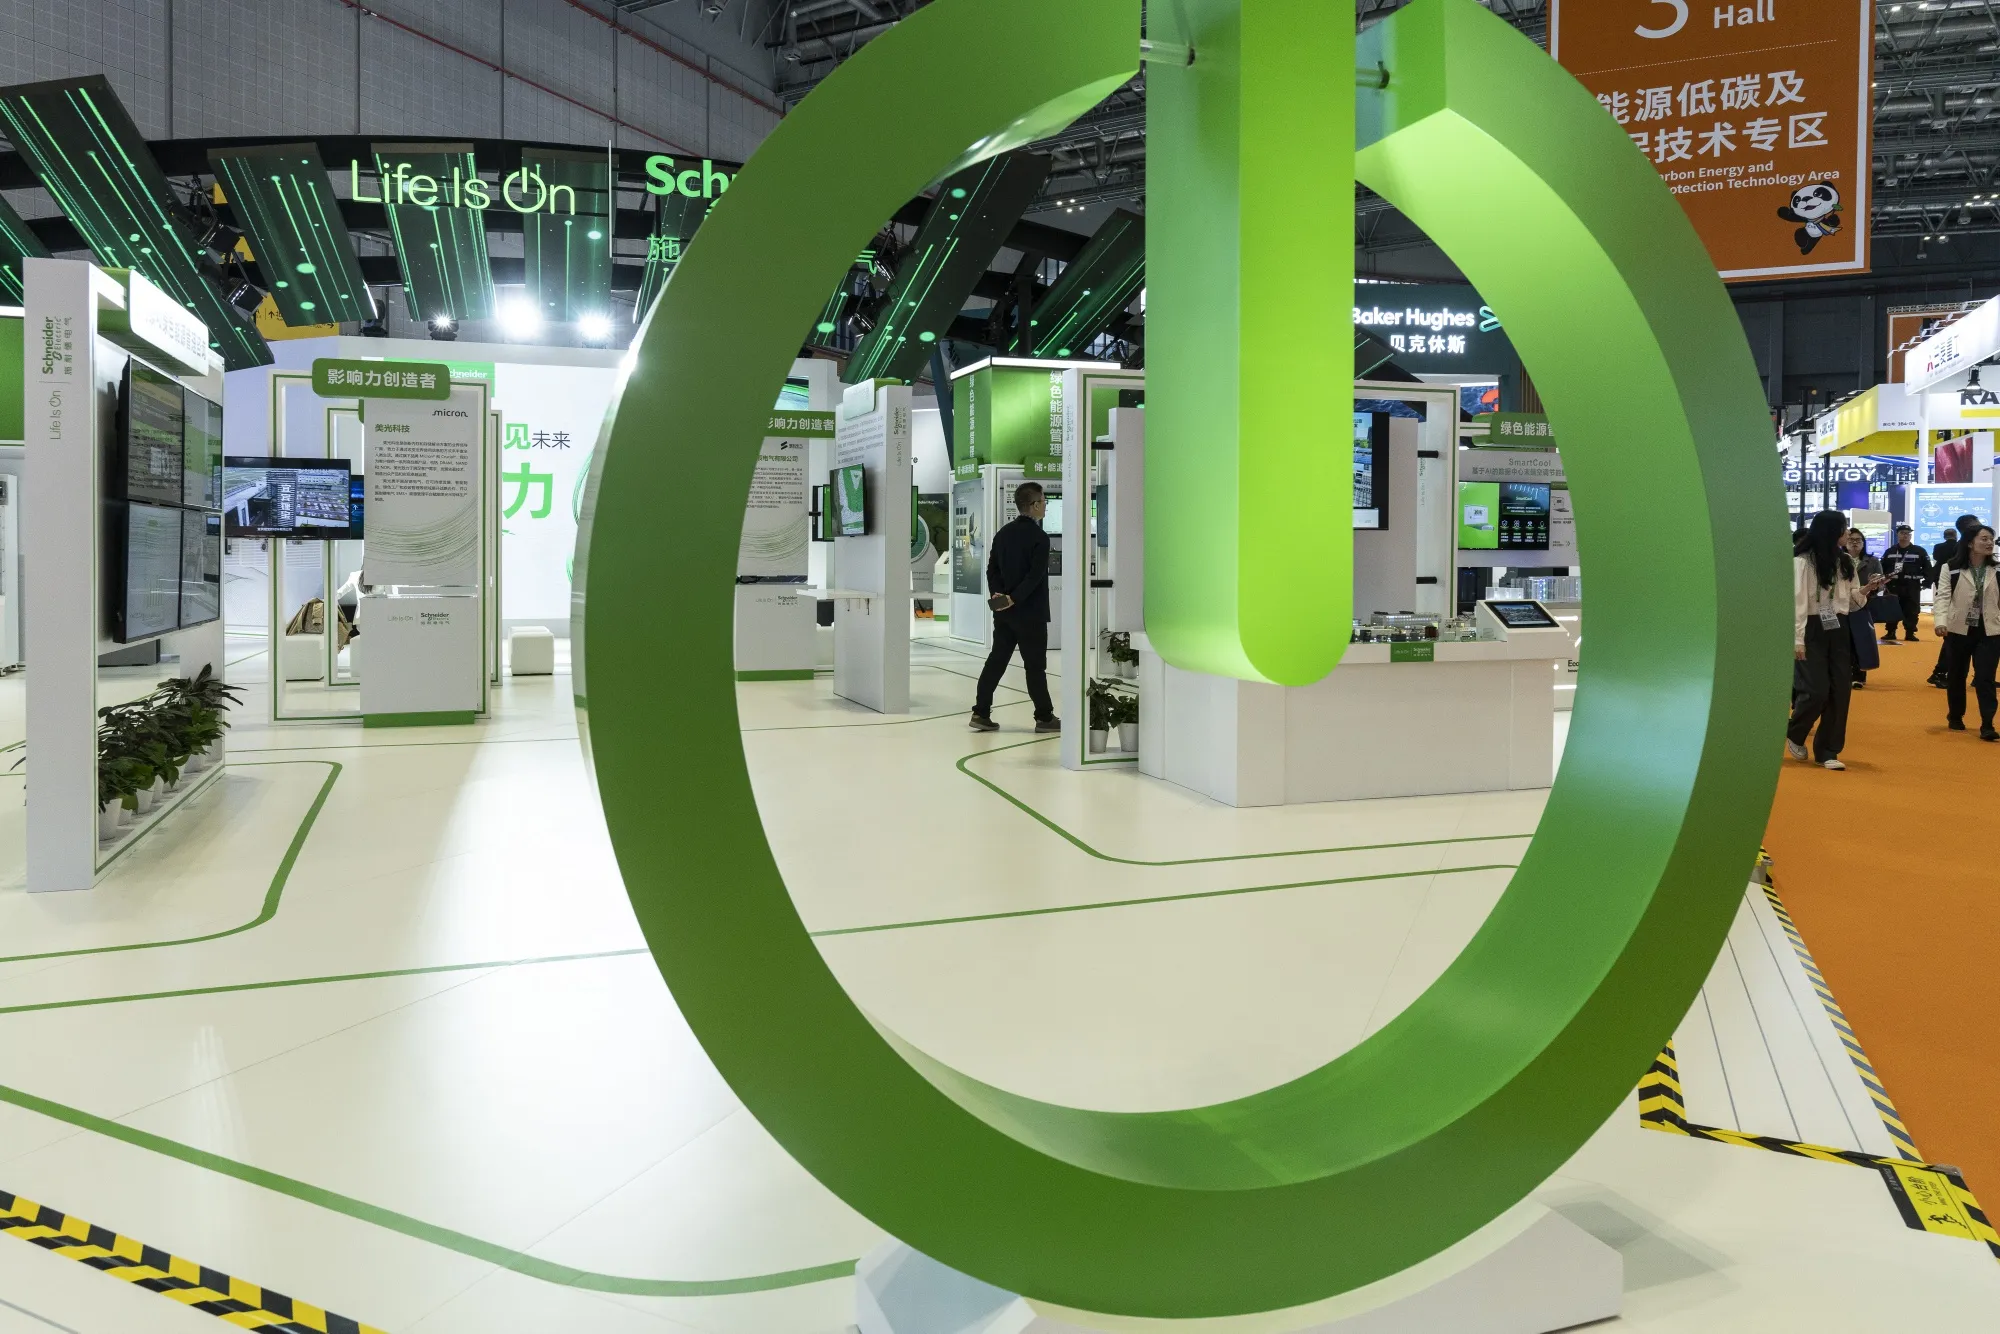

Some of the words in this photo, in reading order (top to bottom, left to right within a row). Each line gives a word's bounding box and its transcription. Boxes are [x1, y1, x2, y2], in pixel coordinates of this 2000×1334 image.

[1713, 0, 1776, 29] Hall
[1596, 70, 1807, 125] 能源低碳及
[645, 154, 738, 199] Sch
[1698, 164, 1745, 178] Energy
[1748, 160, 1774, 174] and
[350, 159, 439, 206] Life
[453, 167, 492, 211] Is
[502, 166, 576, 216] On
[1727, 172, 1805, 190] Technology
[1807, 170, 1840, 182] Area
[1405, 308, 1476, 332] Hughes
[42, 316, 54, 375] Schneider
[1390, 334, 1466, 354] 贝克休斯
[327, 368, 437, 390] 影响力创造者
[48, 390, 62, 408] On
[50, 410, 62, 419] Is
[432, 408, 469, 418] micron
[1049, 370, 1063, 456] 绿色能源管理
[49, 420, 62, 440] Life
[375, 423, 410, 433] 美光科技
[1508, 457, 1552, 467] SmartCool
